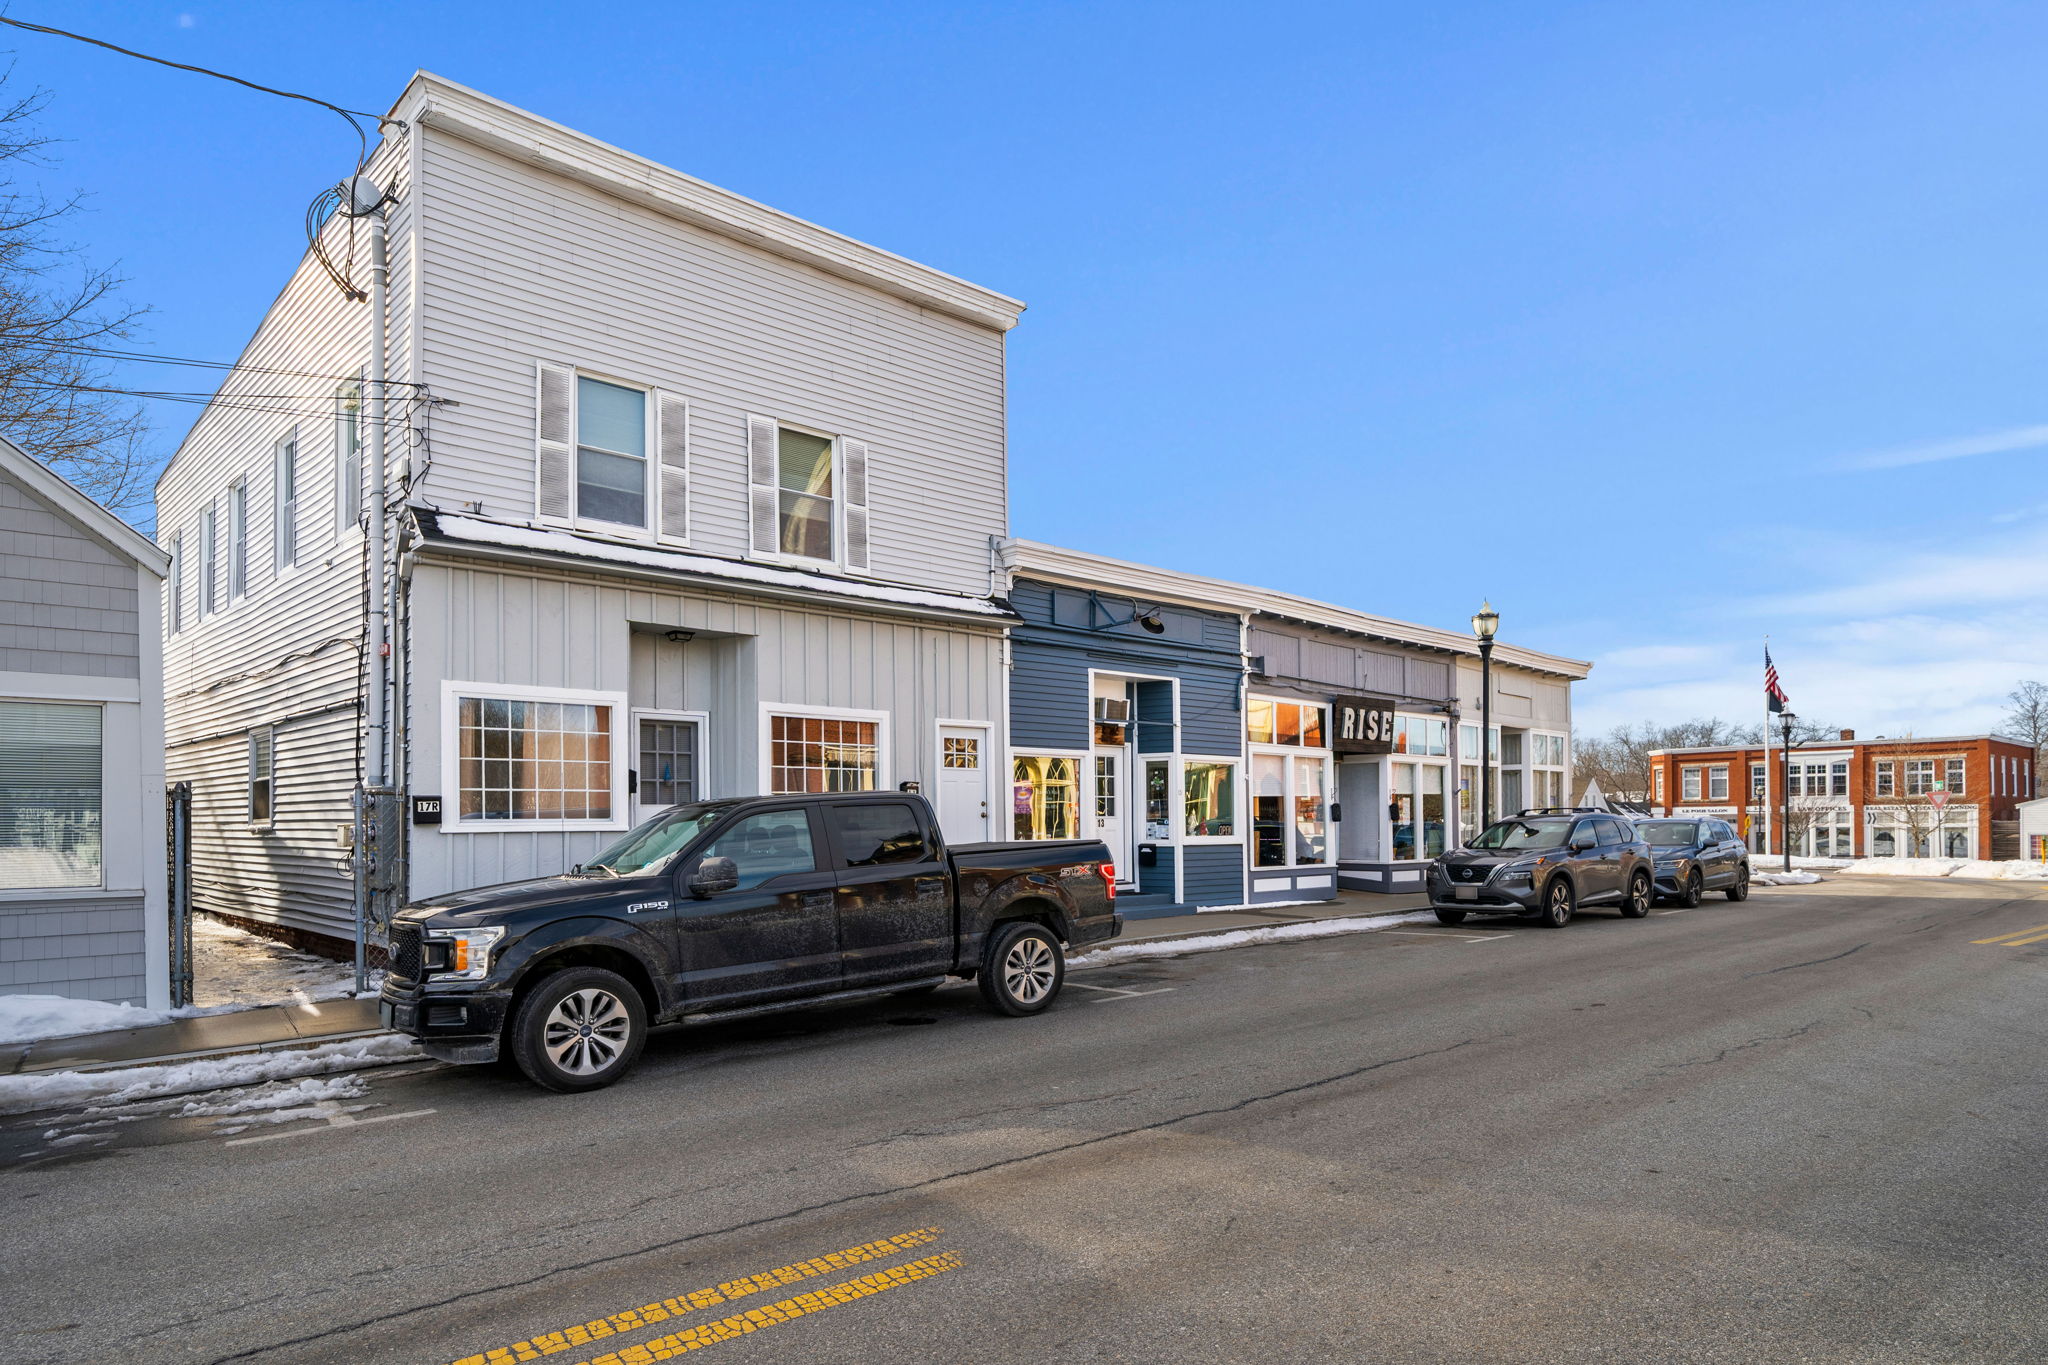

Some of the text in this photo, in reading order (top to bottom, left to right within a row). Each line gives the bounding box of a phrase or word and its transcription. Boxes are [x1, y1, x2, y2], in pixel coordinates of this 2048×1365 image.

[1342, 706, 1393, 742] RISE
[419, 801, 439, 812] 17R
[1097, 818, 1105, 828] 13
[1218, 825, 1233, 836] OPEN
